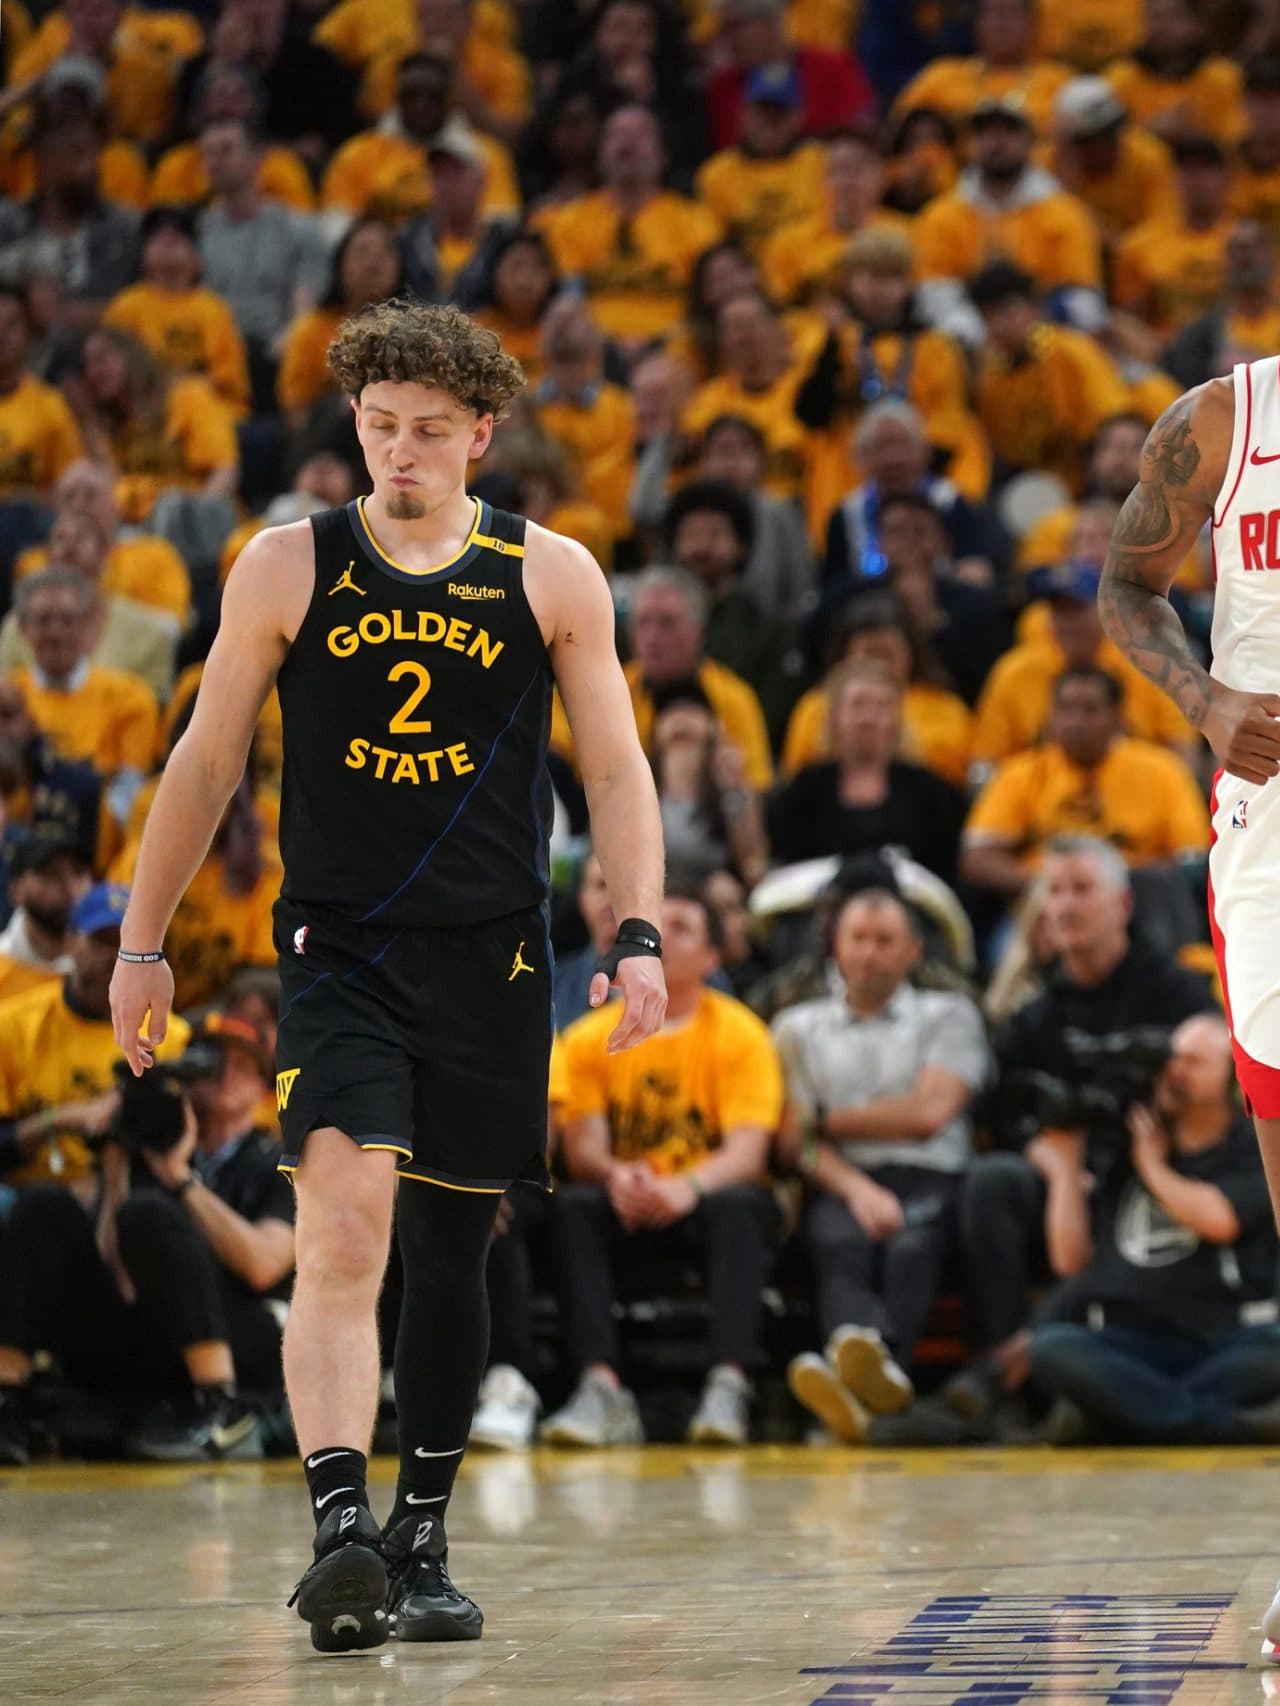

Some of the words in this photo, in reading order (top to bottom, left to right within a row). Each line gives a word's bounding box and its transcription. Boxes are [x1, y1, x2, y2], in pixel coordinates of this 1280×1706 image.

[448, 582, 505, 600] Rakuten
[327, 610, 505, 669] GOLDEN
[387, 660, 432, 734] 2
[344, 738, 475, 785] STATE
